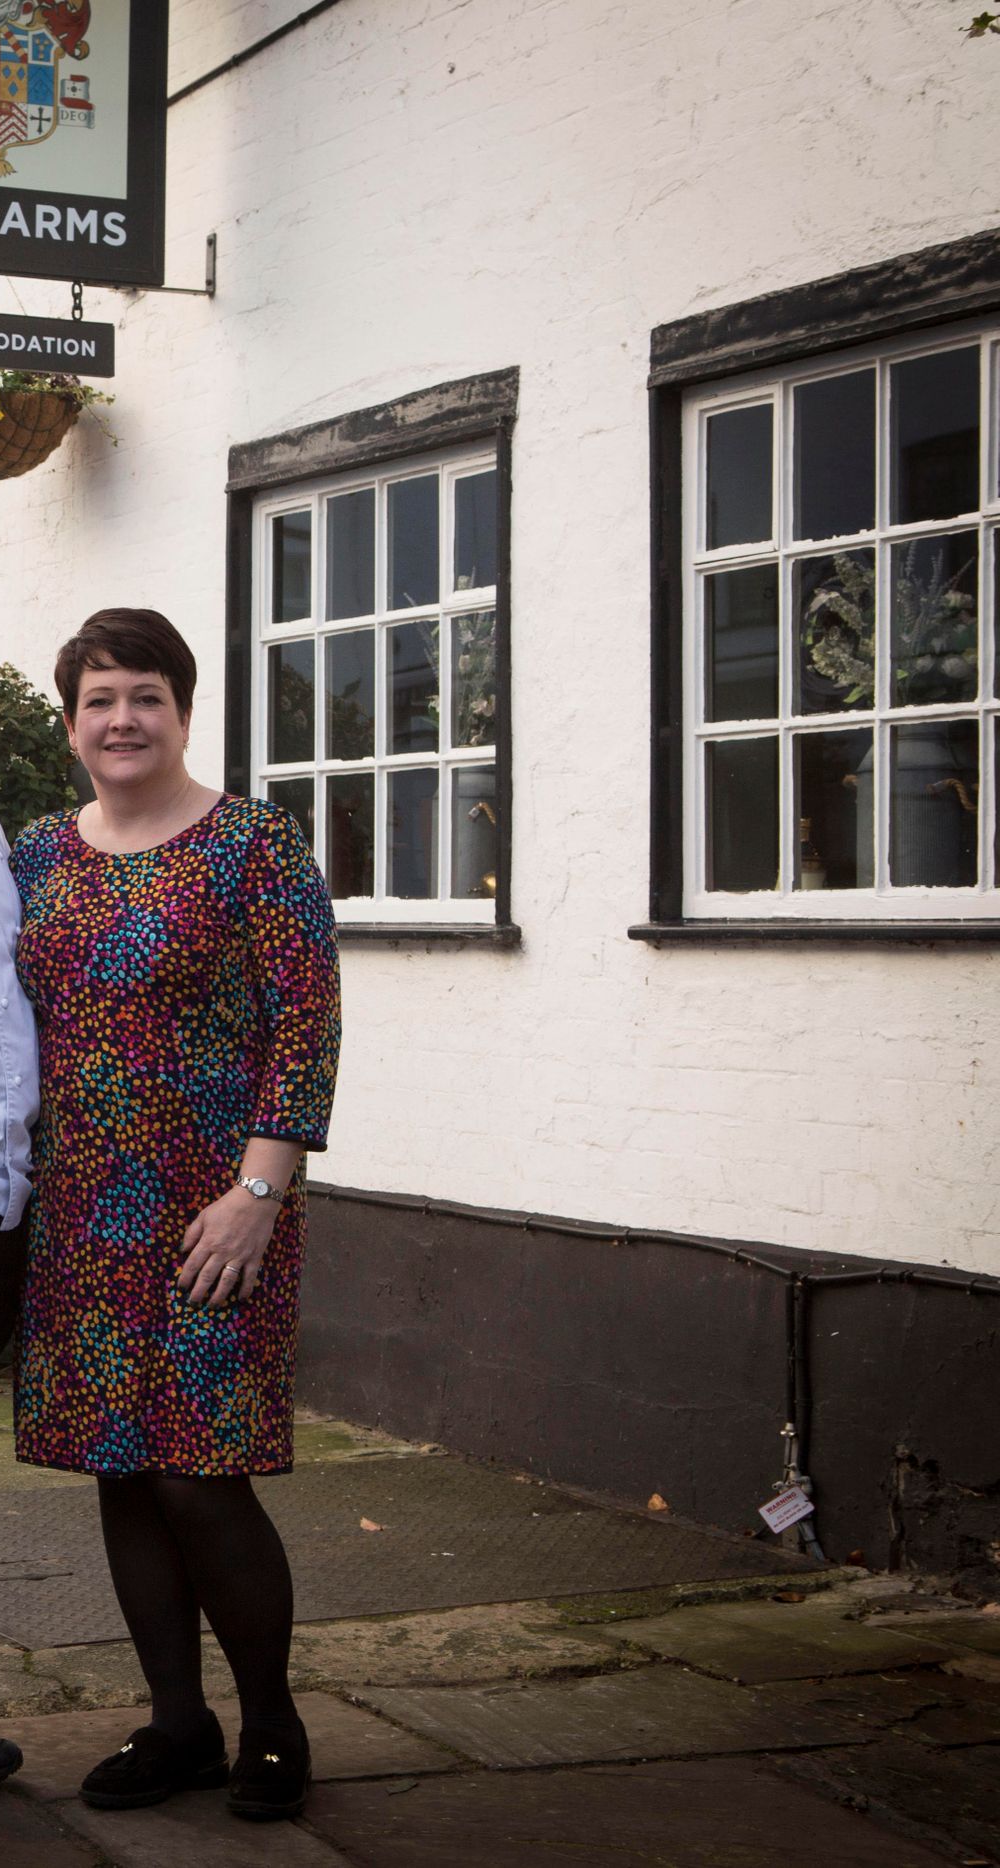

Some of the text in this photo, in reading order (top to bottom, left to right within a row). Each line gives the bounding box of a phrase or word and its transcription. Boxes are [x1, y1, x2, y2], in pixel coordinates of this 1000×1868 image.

[60, 109, 88, 122] DEO
[0, 201, 128, 247] ARMS
[766, 1492, 797, 1513] WARNING
